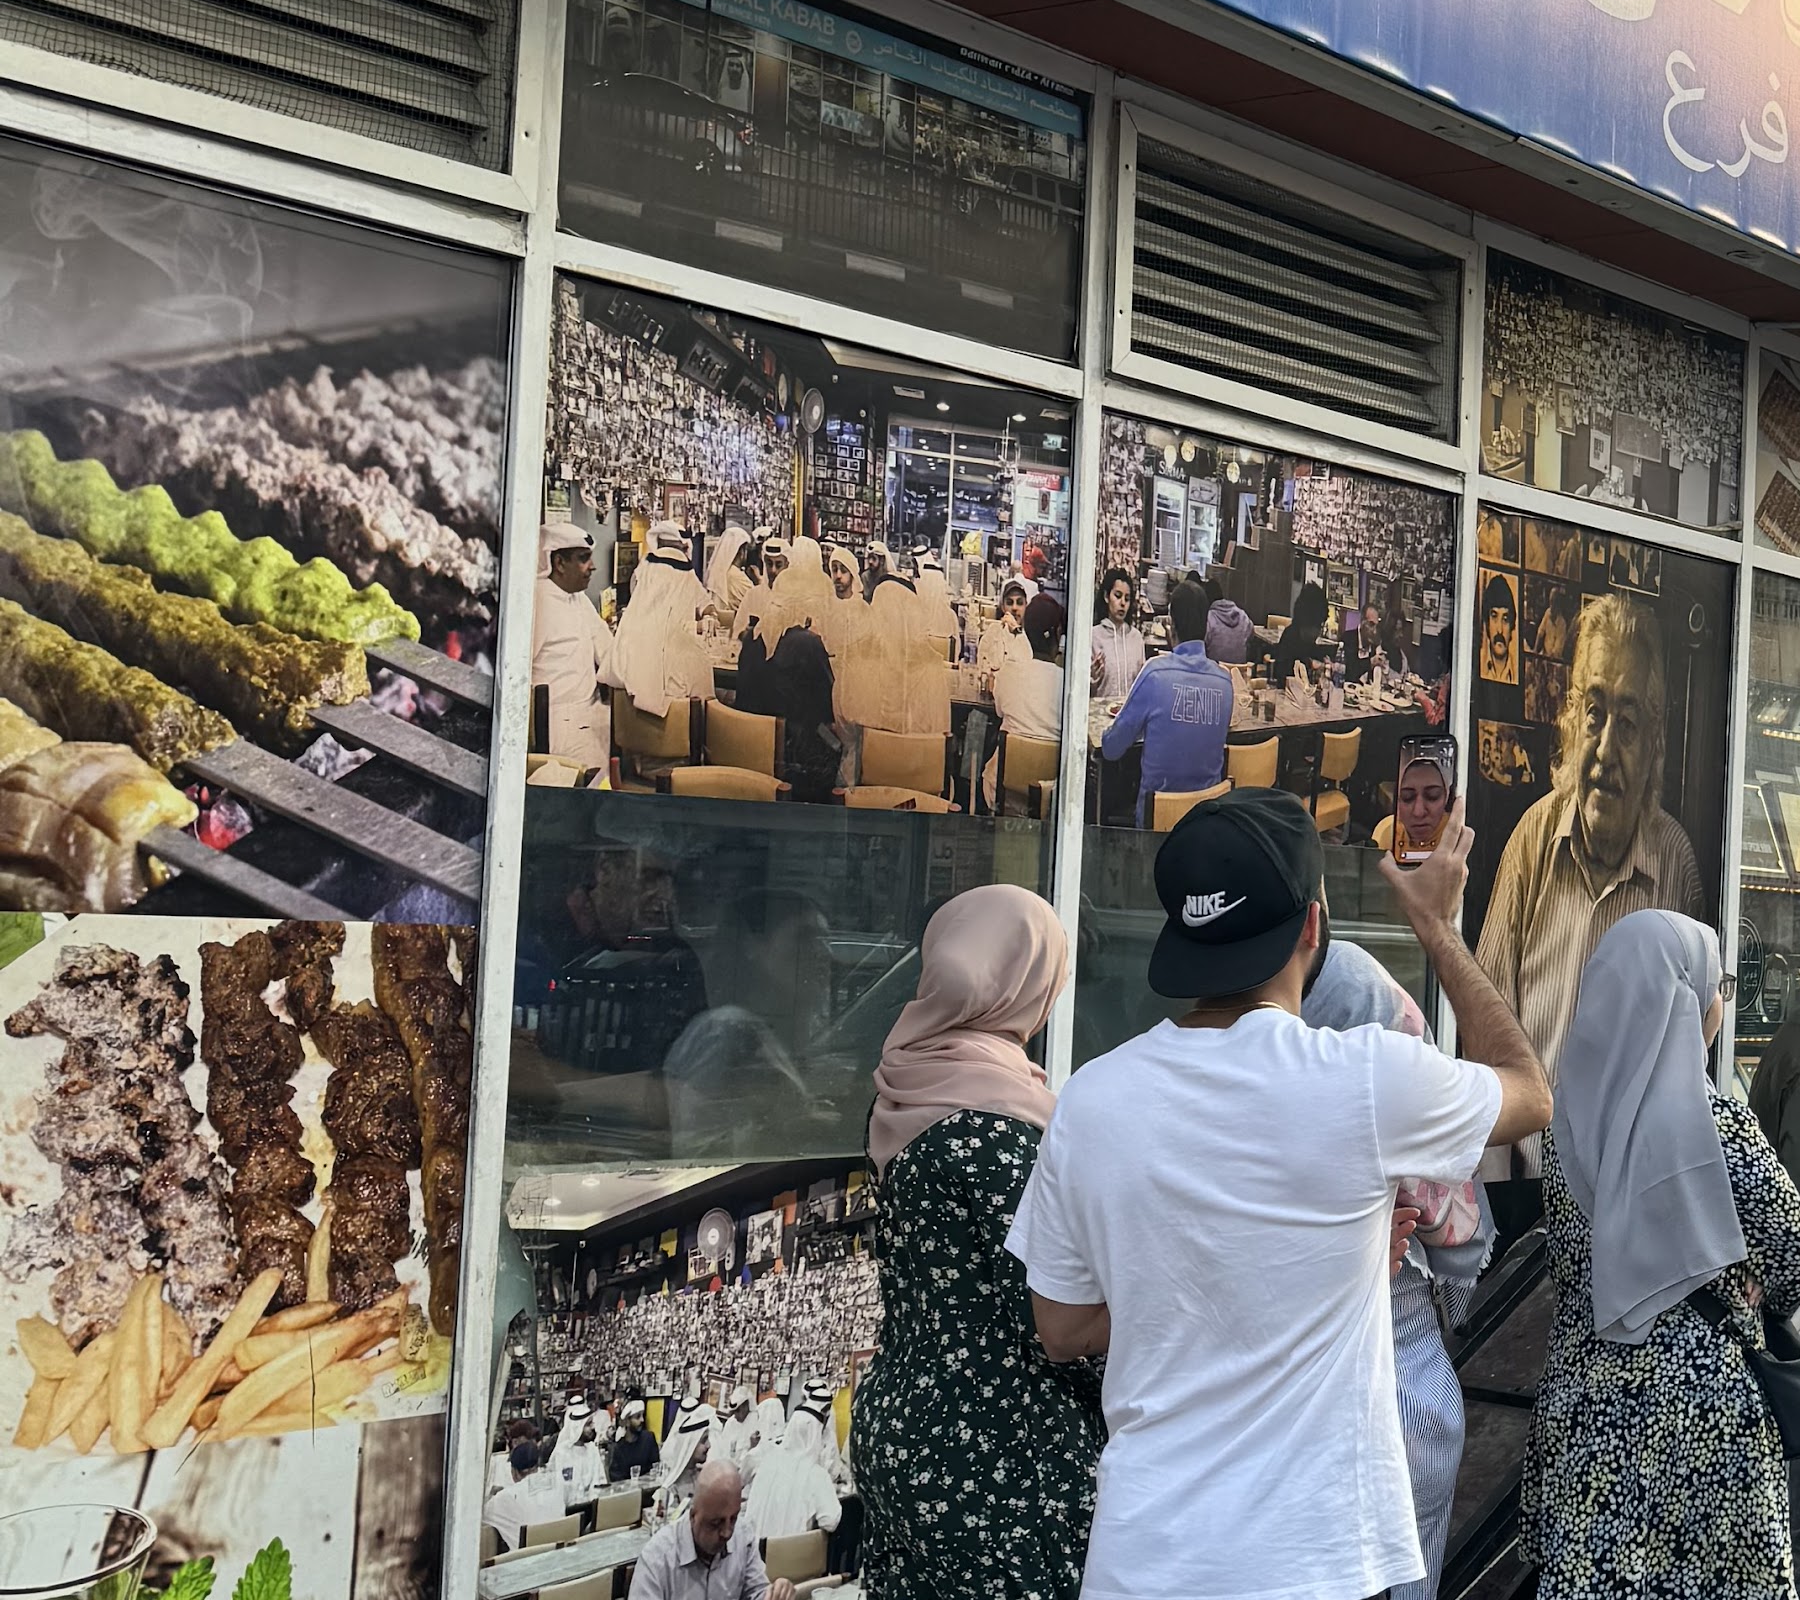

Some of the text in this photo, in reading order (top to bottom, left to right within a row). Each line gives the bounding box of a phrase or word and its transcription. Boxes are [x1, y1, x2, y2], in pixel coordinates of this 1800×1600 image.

[1662, 48, 1789, 179] فرع
[1171, 683, 1222, 726] ZENIT
[1186, 891, 1226, 915] NIKE
